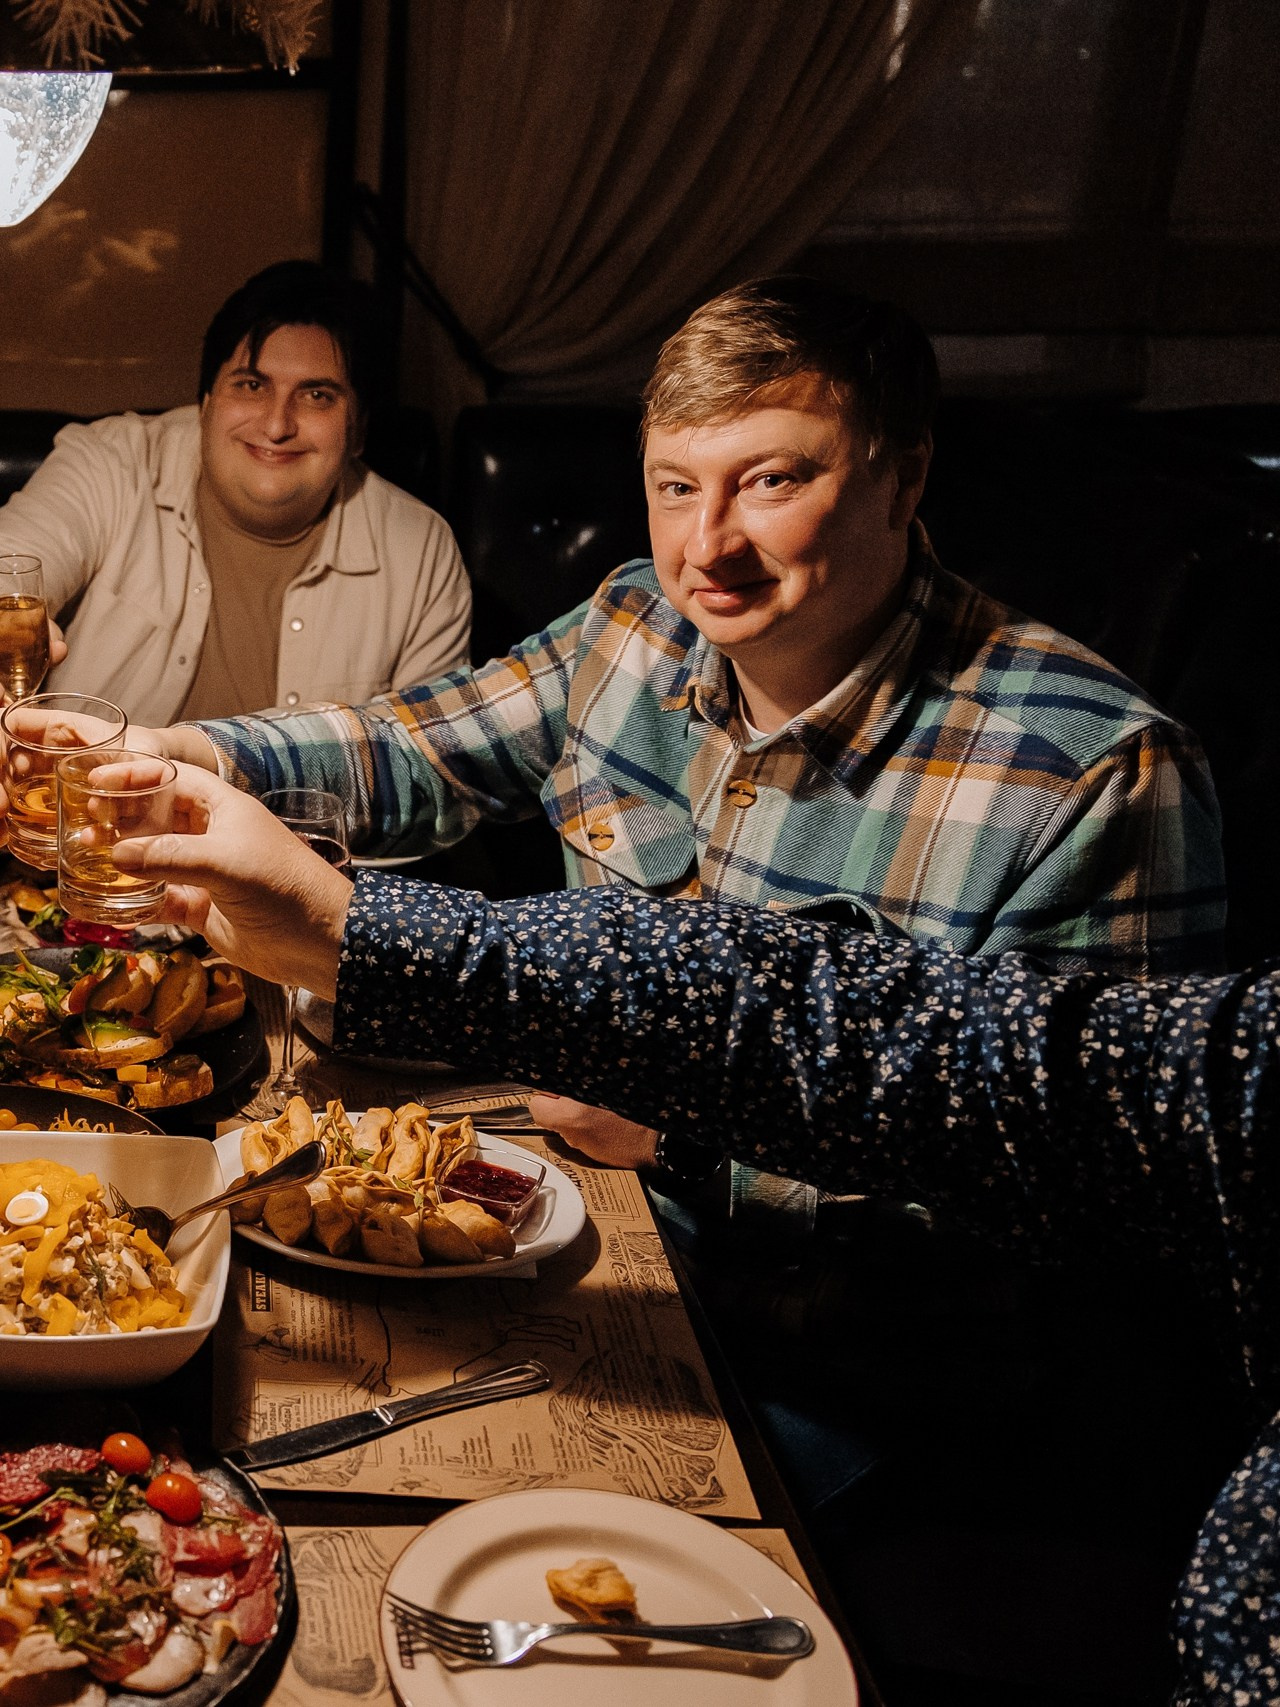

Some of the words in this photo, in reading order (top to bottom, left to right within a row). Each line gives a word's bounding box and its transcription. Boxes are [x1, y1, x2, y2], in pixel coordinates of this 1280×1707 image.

[255, 1271, 266, 1310] STEAK
[266, 1402, 278, 1436] Деловые
[281, 1407, 292, 1431] обеды
